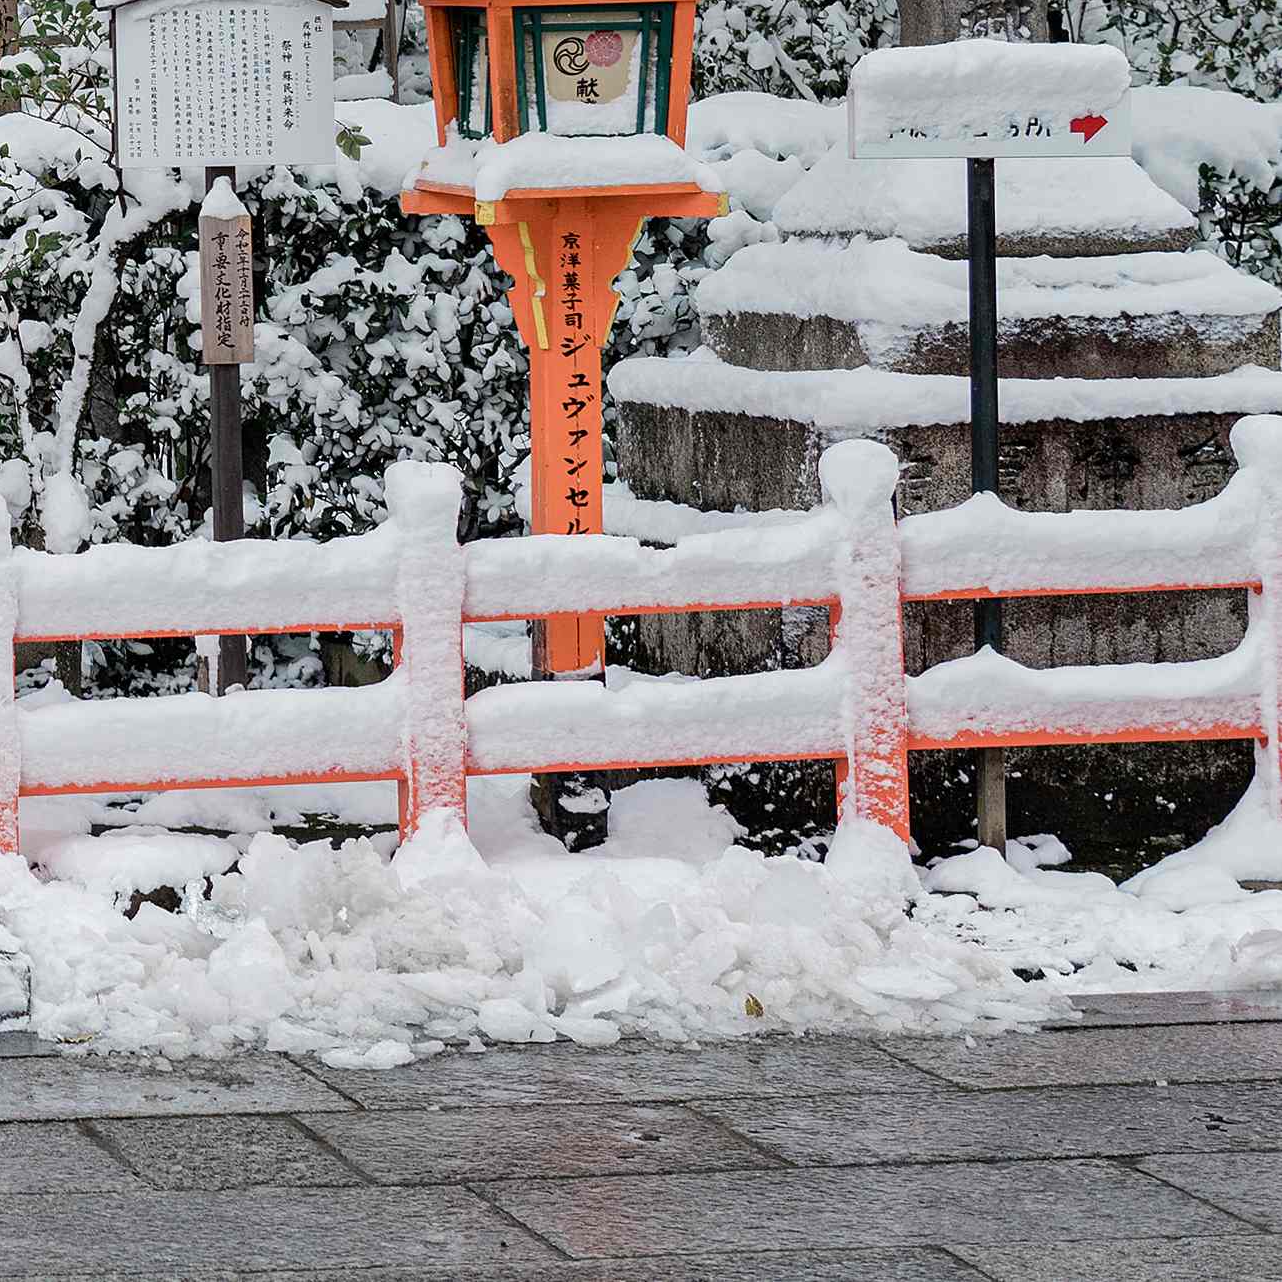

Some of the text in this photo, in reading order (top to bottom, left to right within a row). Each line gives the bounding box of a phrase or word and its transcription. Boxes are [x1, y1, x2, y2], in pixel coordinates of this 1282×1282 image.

[211, 231, 236, 348] 重要文化財指定
